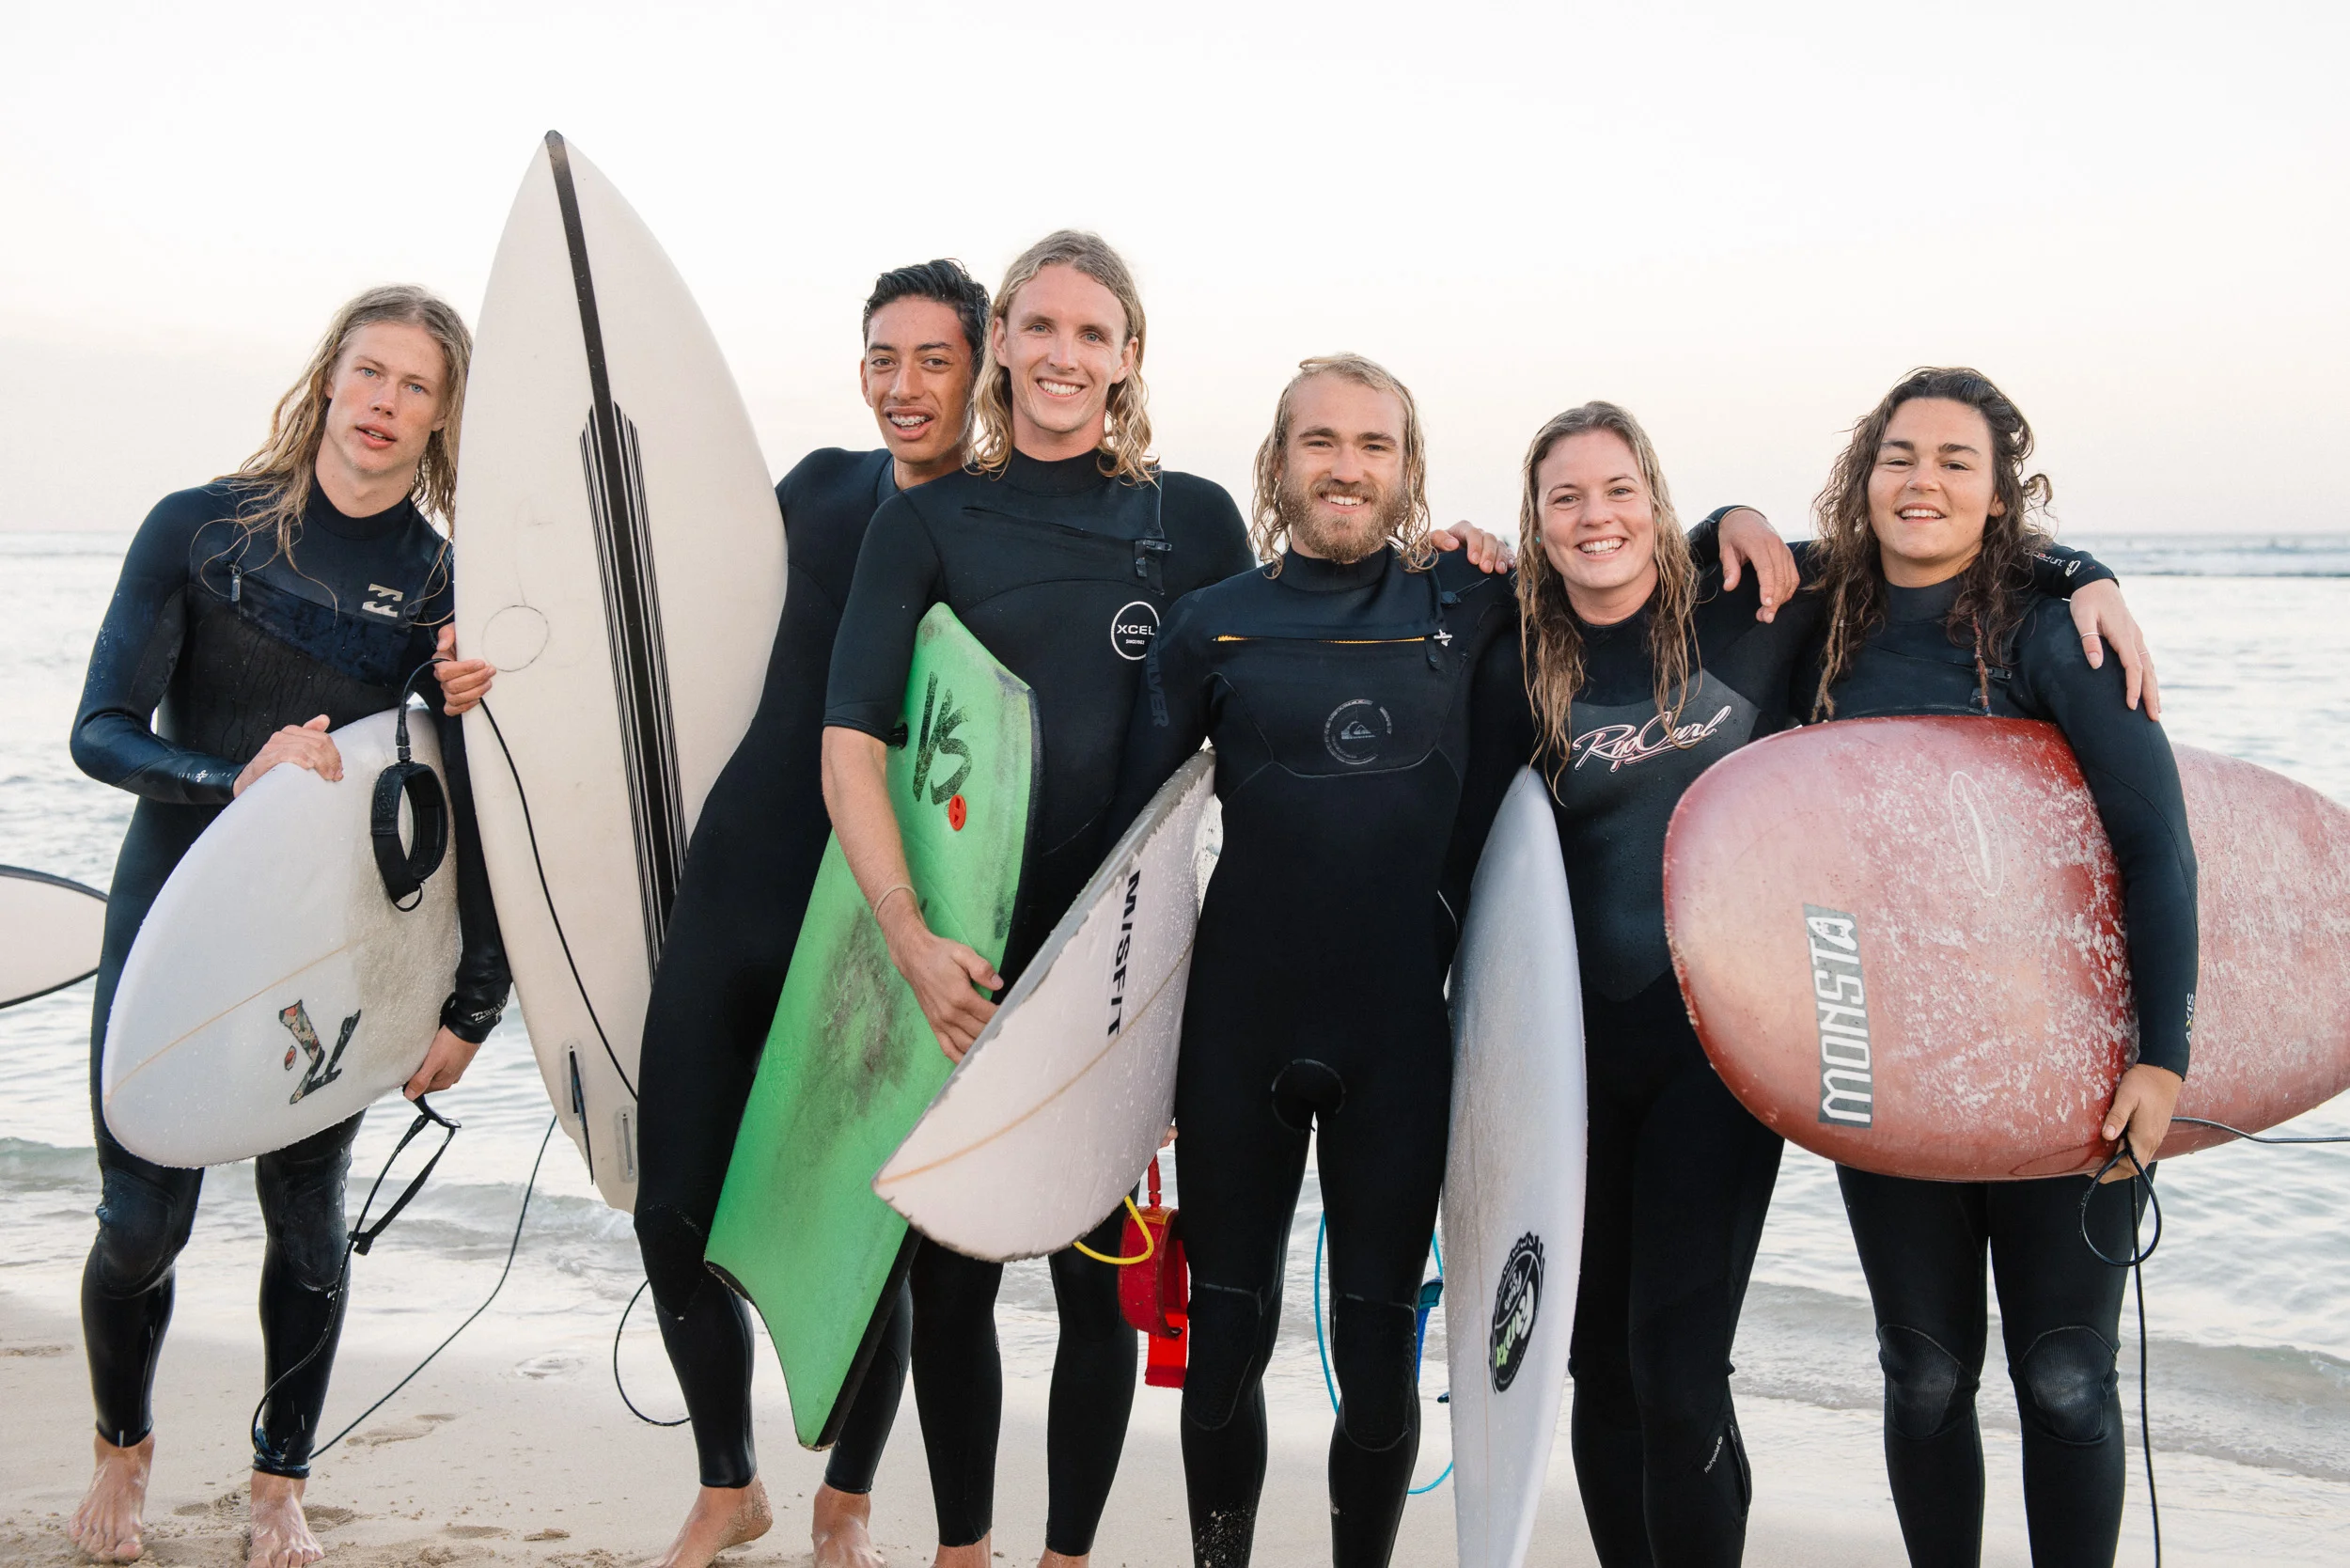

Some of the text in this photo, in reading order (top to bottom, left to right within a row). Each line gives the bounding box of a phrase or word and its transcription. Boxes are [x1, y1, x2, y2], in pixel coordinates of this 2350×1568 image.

[1117, 624, 1155, 635] XCEL
[1107, 870, 1141, 1036] MISFIT
[1807, 917, 1872, 1123] MONSTA
